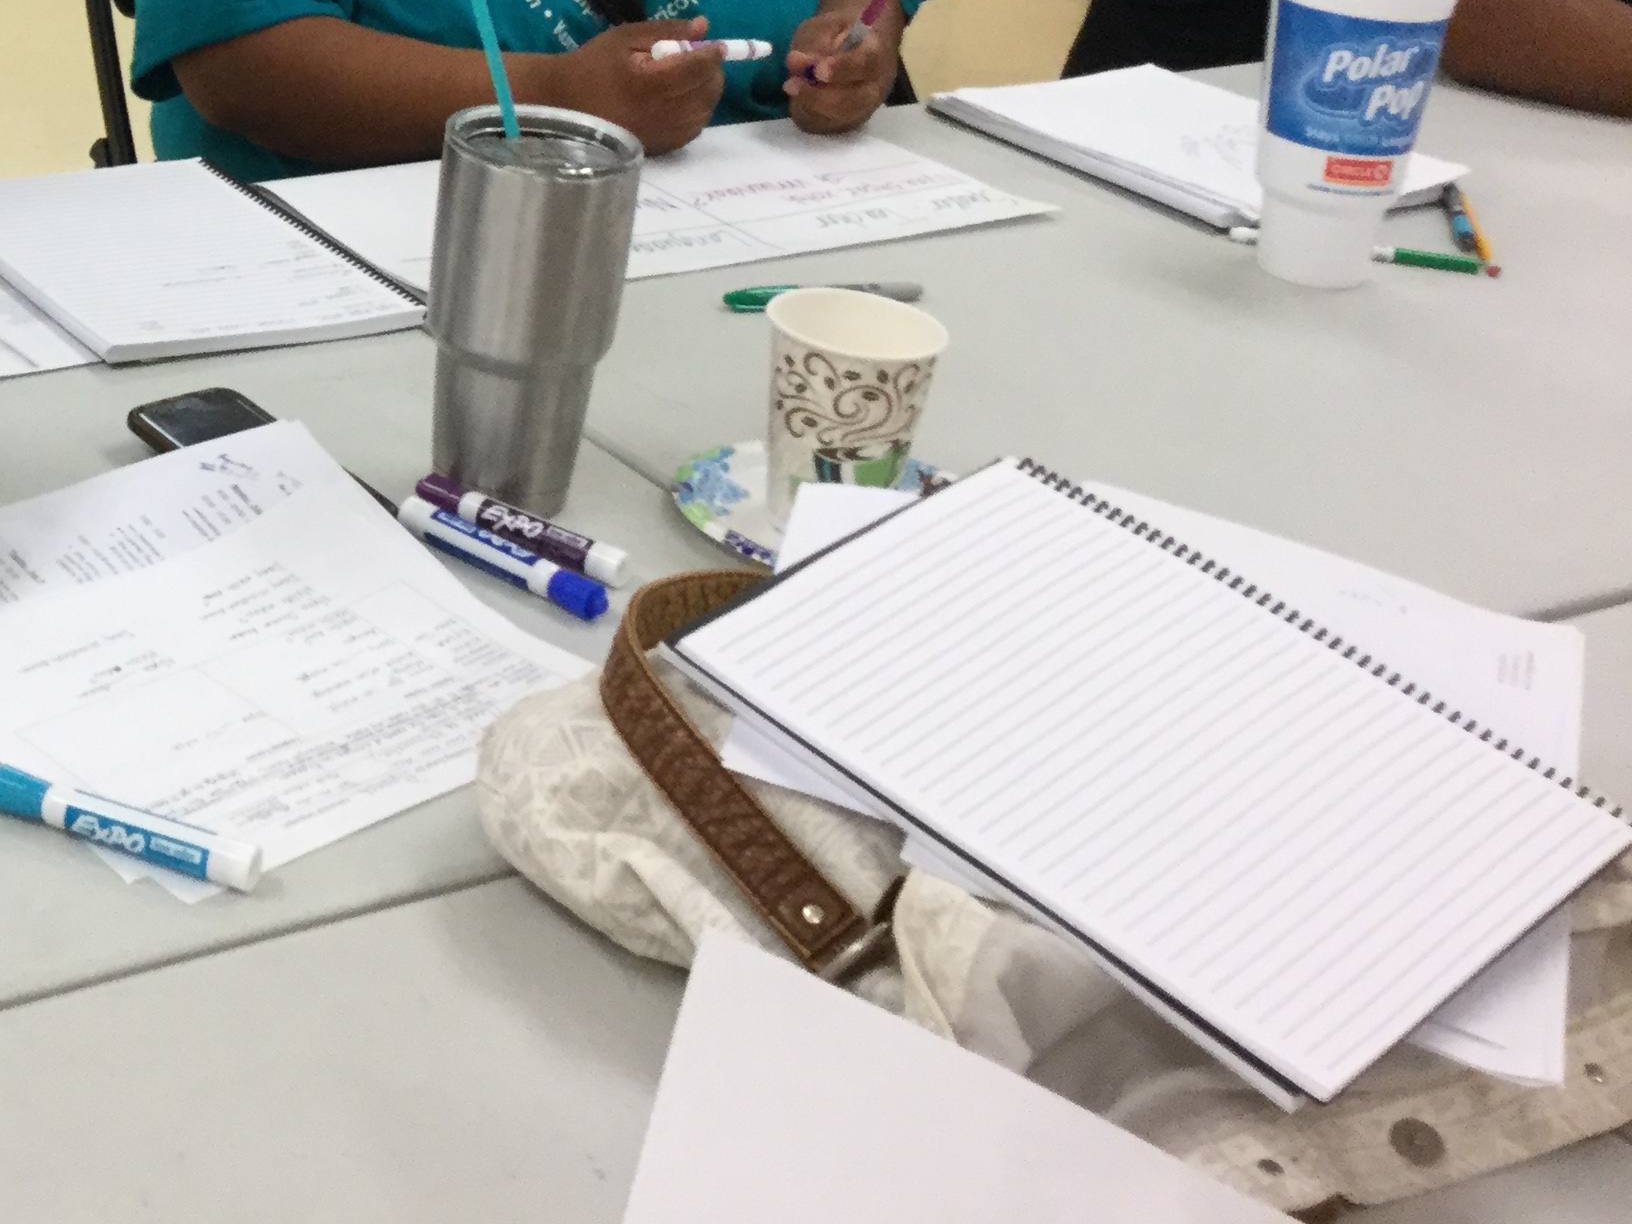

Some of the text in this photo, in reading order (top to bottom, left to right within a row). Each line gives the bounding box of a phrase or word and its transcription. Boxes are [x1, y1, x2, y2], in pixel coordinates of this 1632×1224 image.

[1321, 42, 1420, 84] Polar
[479, 503, 545, 540] EXPO
[70, 814, 146, 854] EXPO
